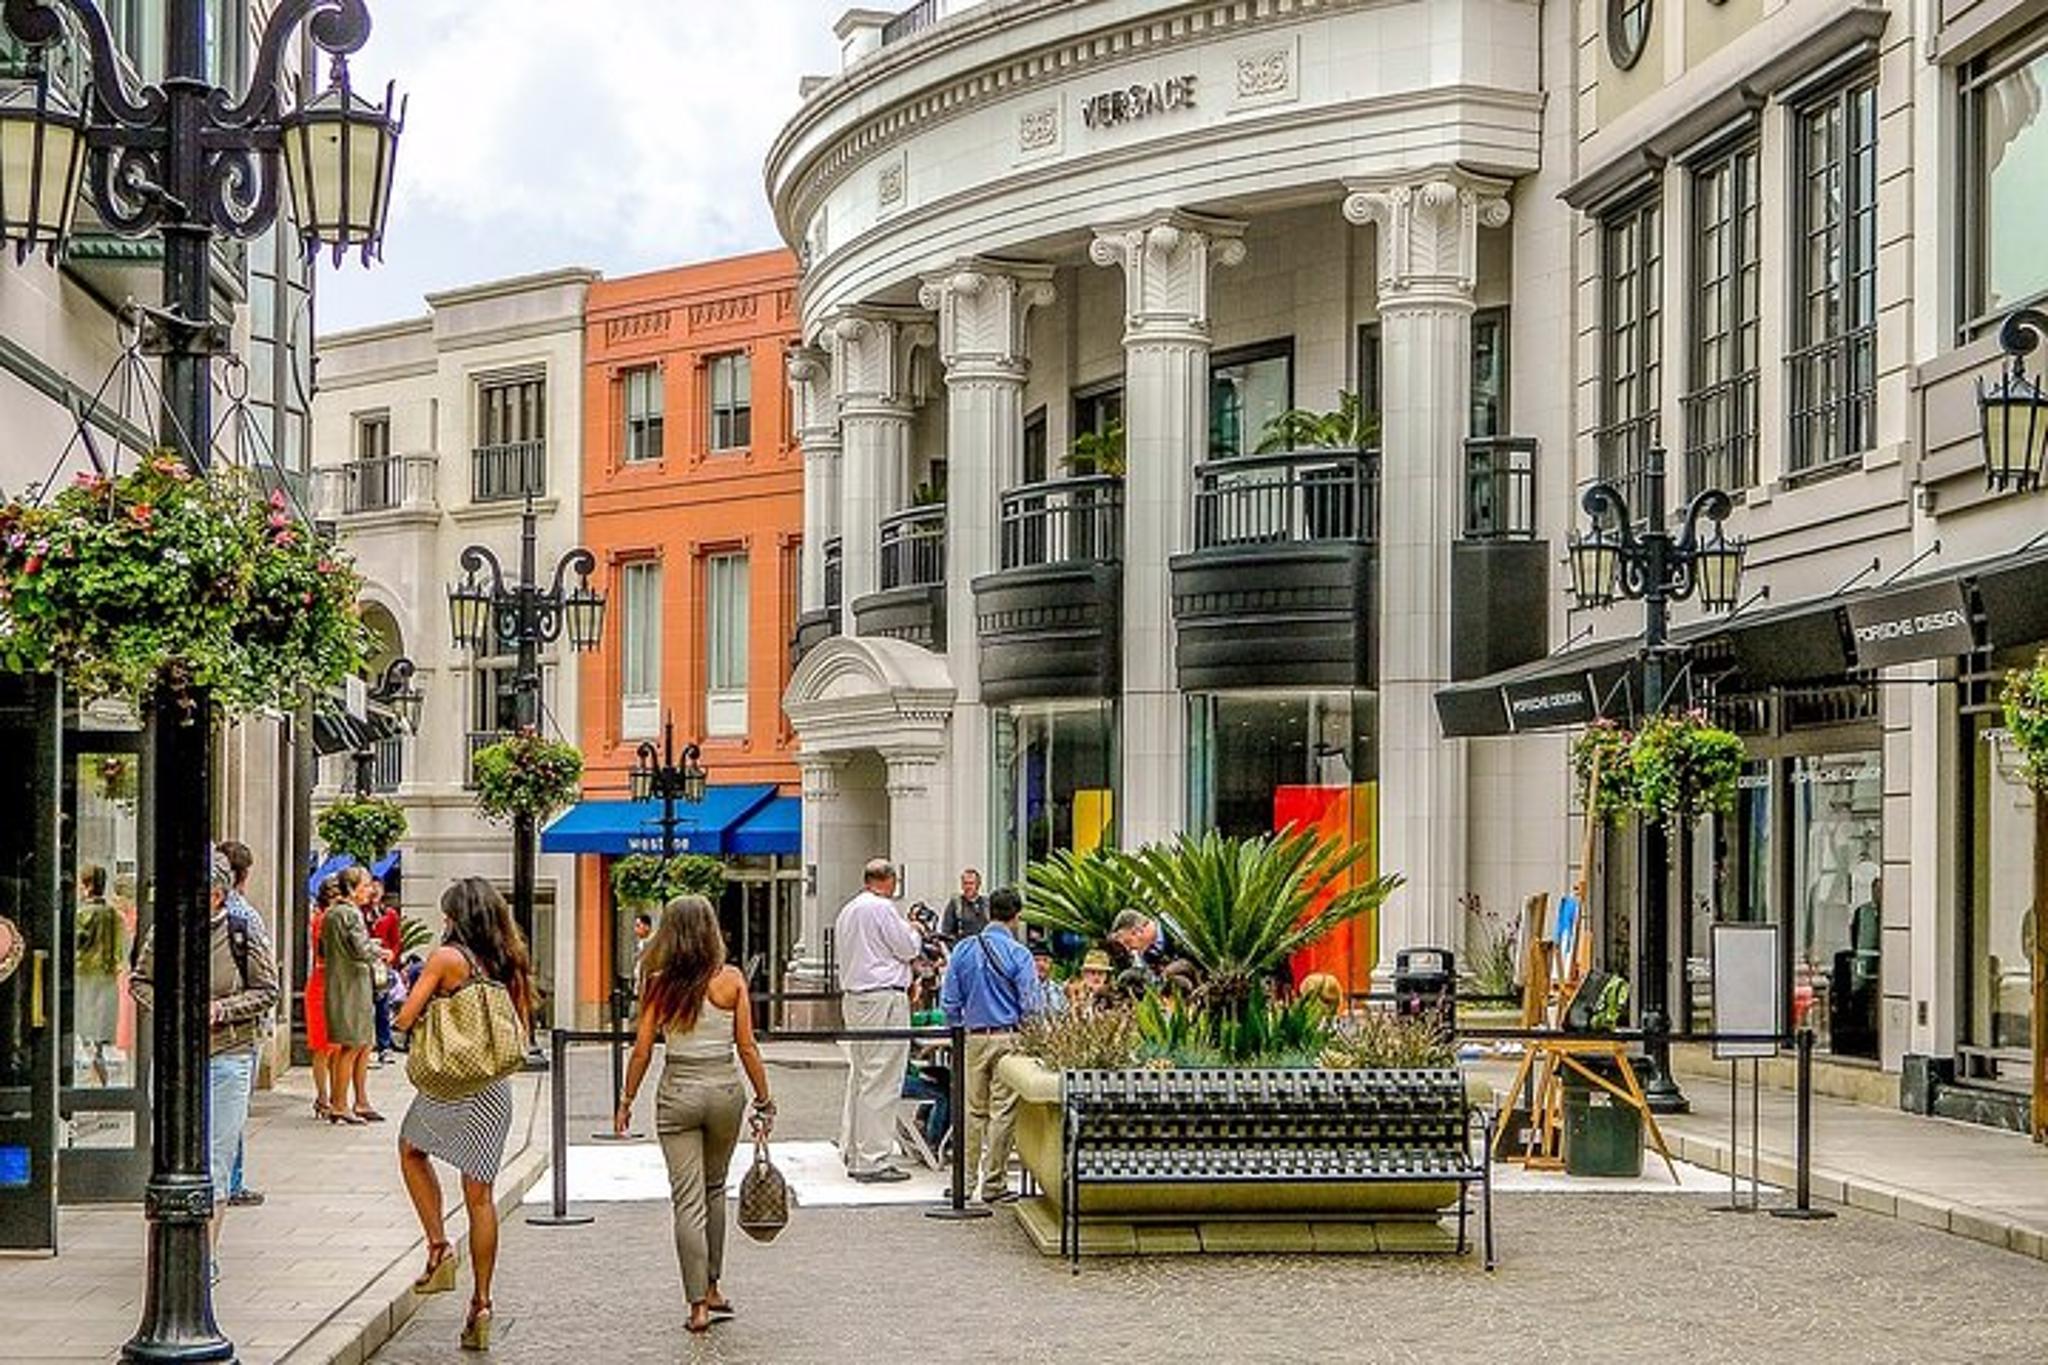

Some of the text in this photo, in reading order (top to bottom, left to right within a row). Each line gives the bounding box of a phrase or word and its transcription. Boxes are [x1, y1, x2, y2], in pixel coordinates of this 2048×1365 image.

[1081, 76, 1198, 129] VERSACE
[1855, 608, 1966, 641] PORSCHE DESIGN
